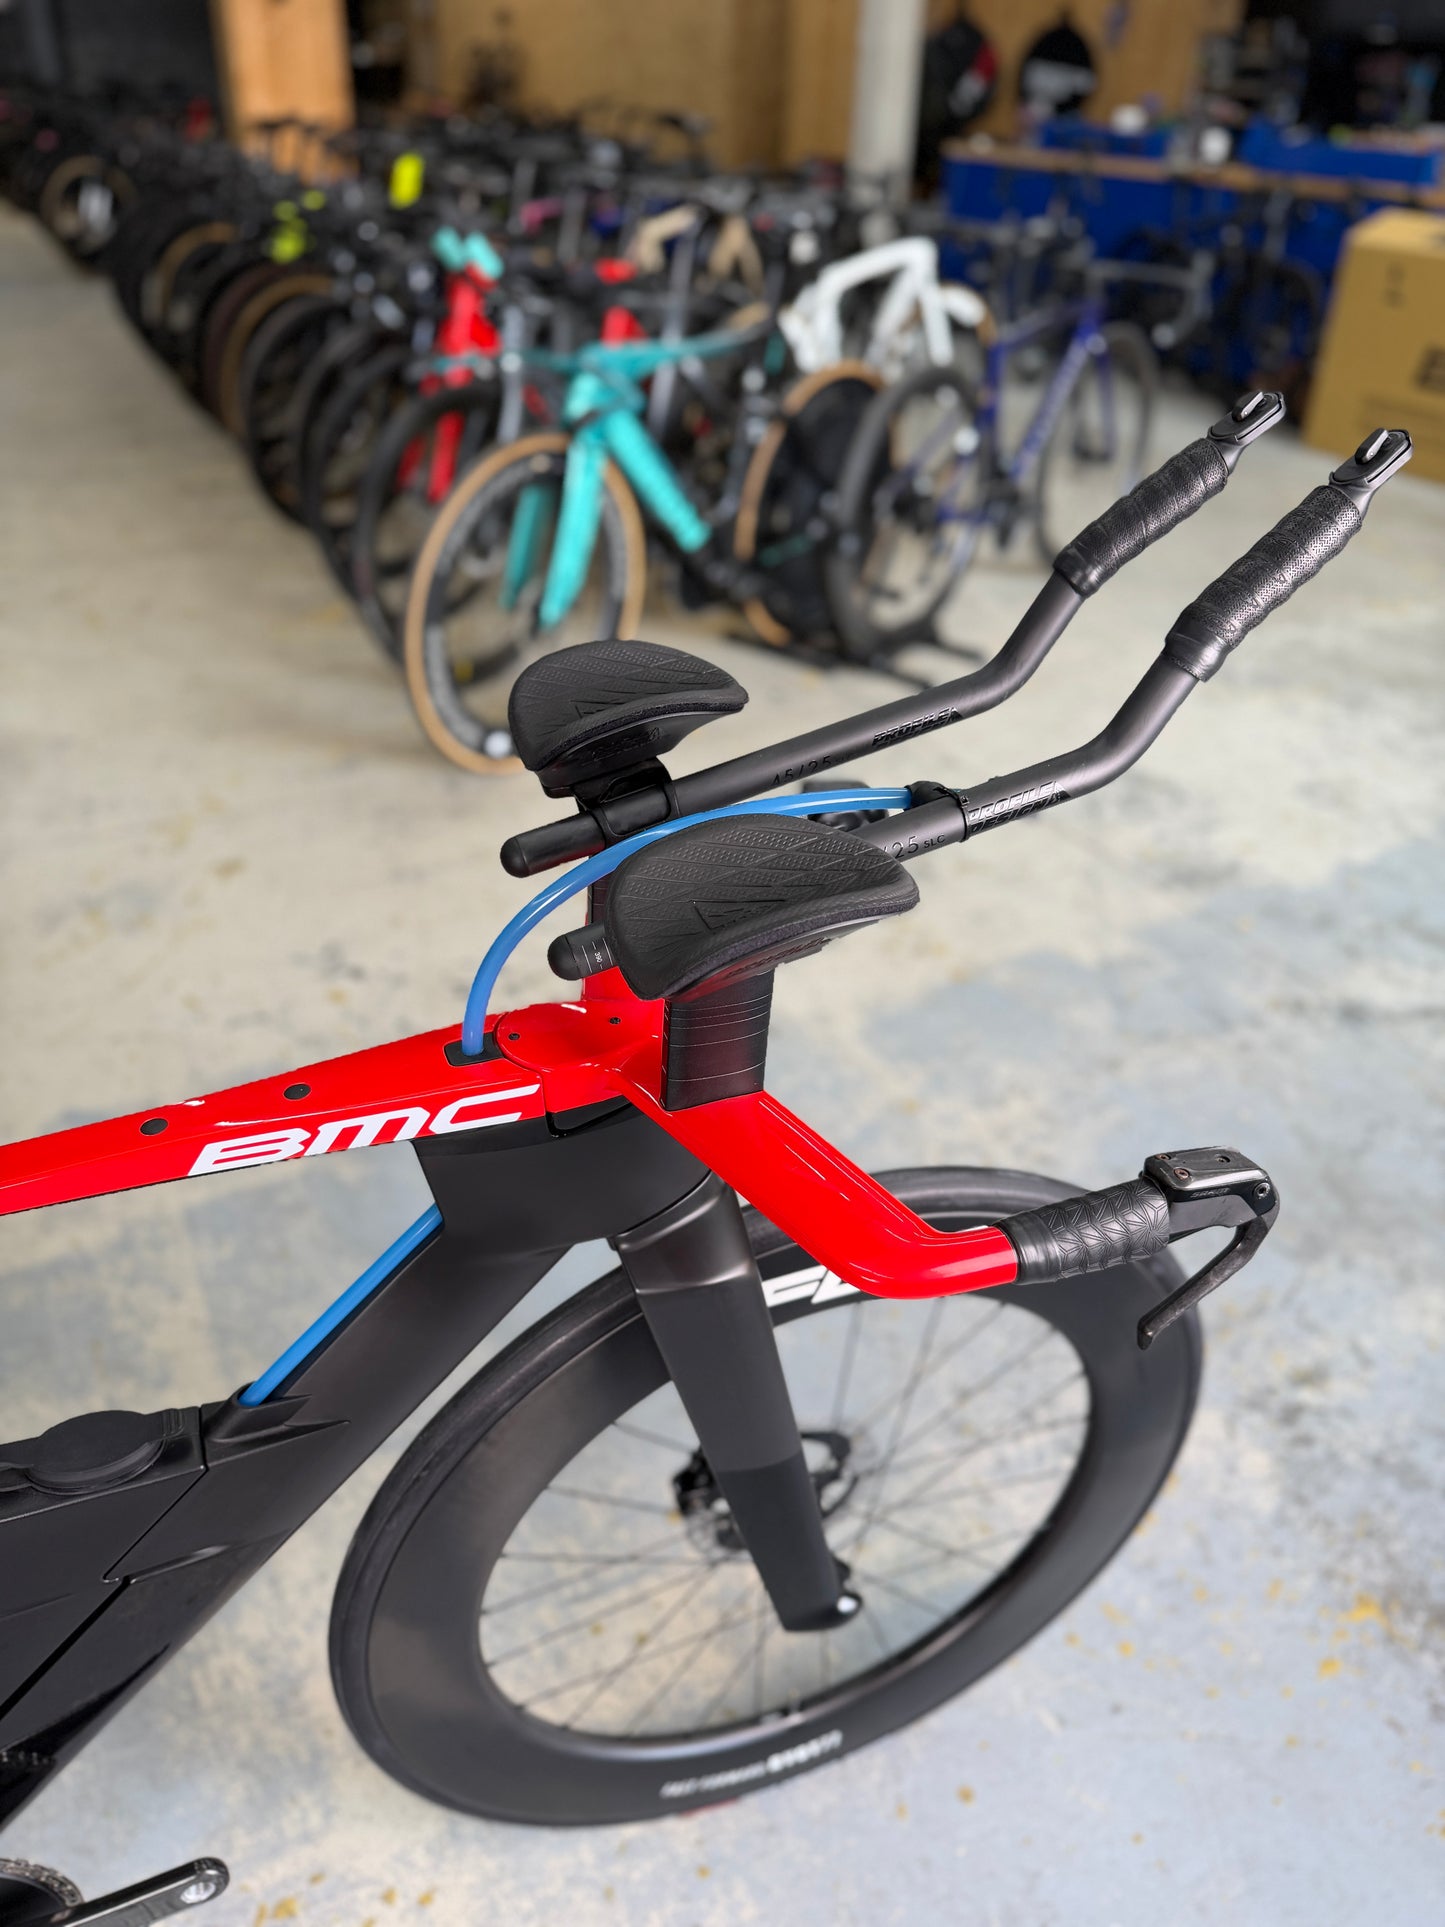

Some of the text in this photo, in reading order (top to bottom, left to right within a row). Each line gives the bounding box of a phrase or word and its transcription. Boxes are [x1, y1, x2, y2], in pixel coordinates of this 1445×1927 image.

[967, 780, 1055, 821] PROFILE
[923, 834, 946, 849] SLC
[187, 1083, 541, 1176] BMC
